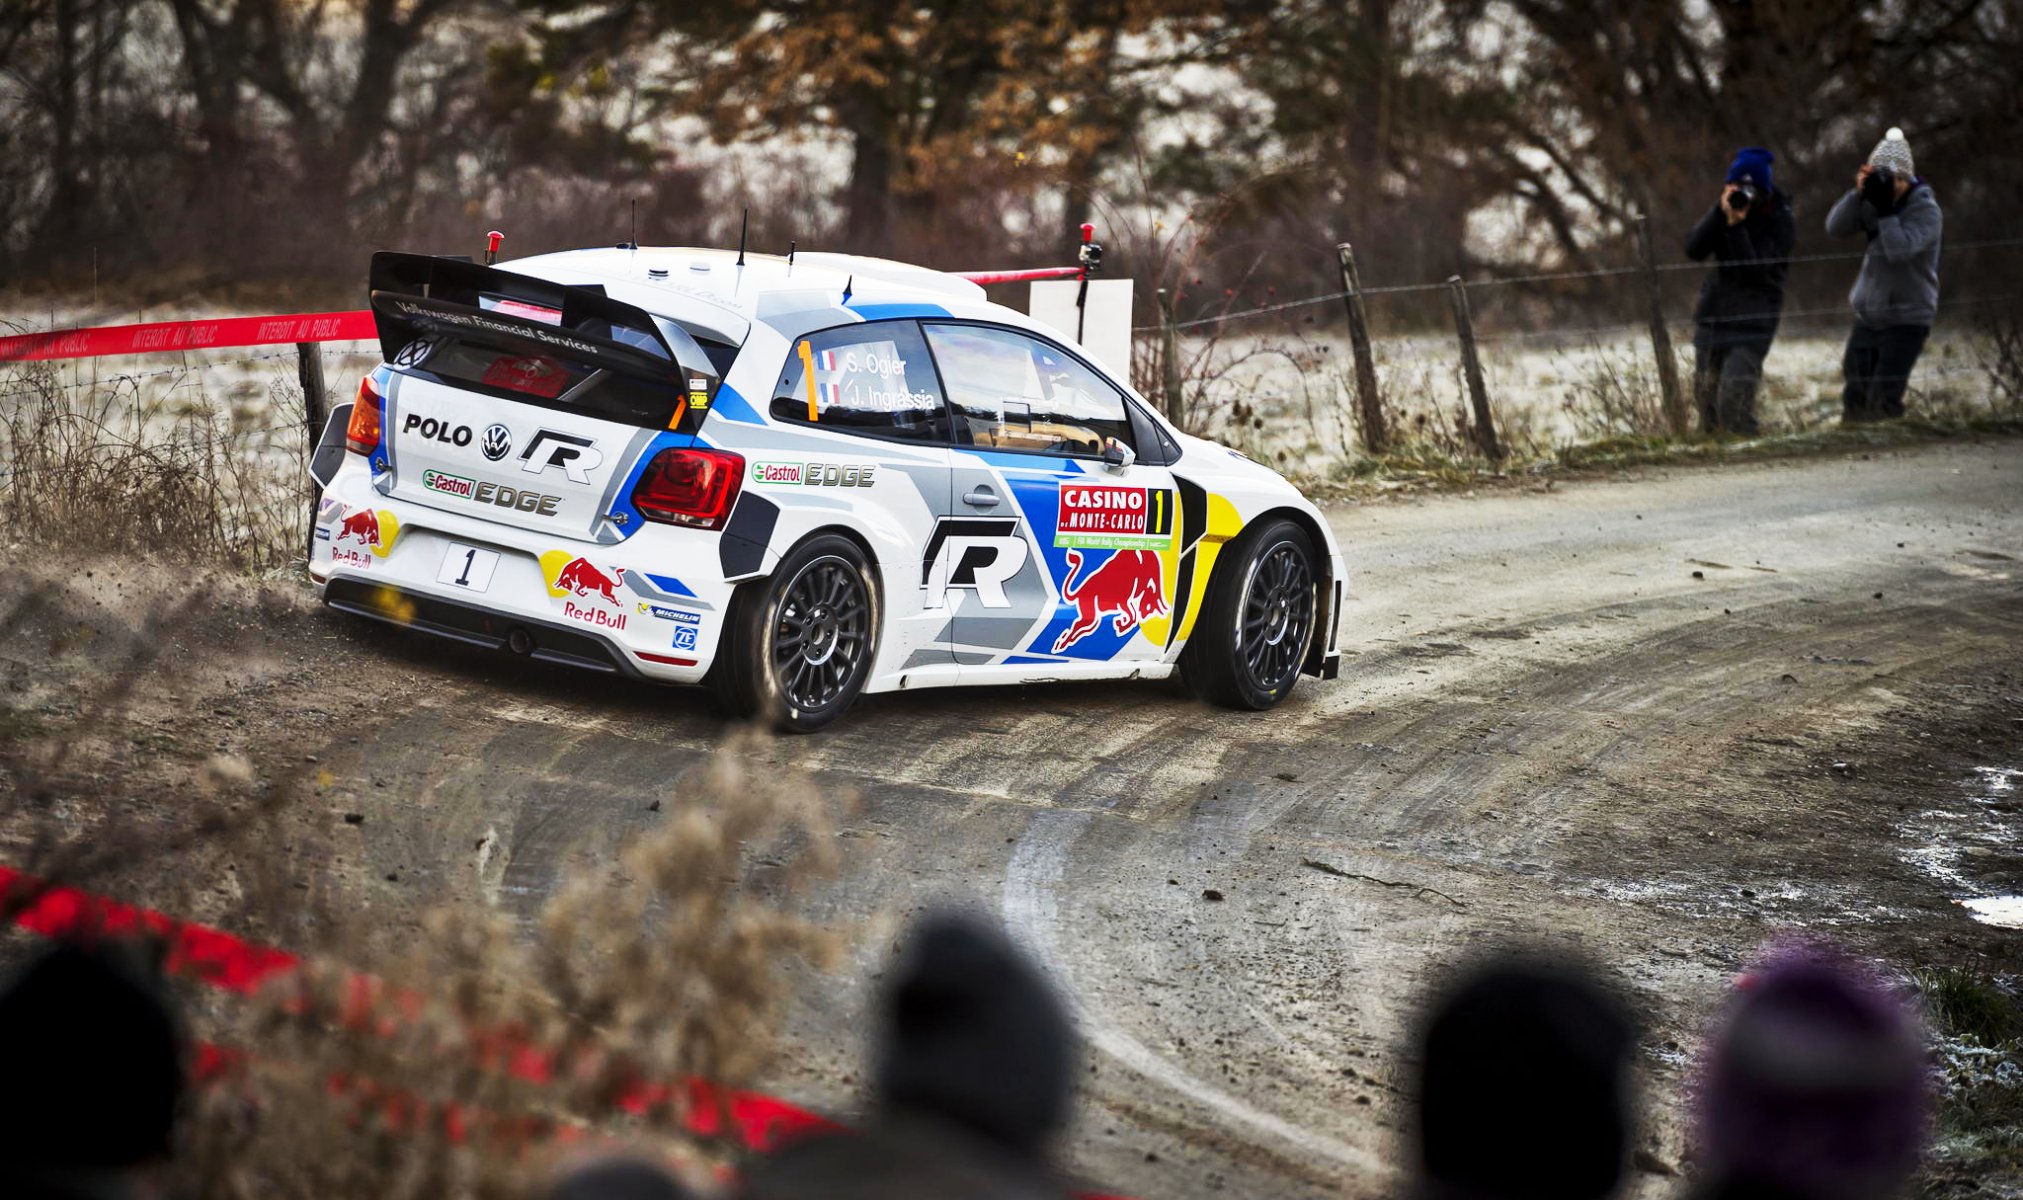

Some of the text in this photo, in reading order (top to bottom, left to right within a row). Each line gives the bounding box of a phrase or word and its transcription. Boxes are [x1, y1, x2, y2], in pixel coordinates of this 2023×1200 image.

[257, 318, 341, 341] INTERDIT AU PUBLIC
[395, 301, 598, 353] Volkswagen Financial Services
[846, 352, 906, 378] S. Ogier
[798, 341, 818, 421] 1
[851, 385, 935, 411] J. Ingrassia
[403, 413, 472, 447] POLO
[517, 426, 603, 485] R
[764, 463, 876, 488] Castrol EDGE
[434, 474, 562, 517] Castrol EDGE
[1064, 489, 1143, 510] CASINO
[1070, 512, 1144, 530] MONTE-CARLO
[1155, 490, 1163, 534] 1
[332, 546, 372, 570] Red Bull
[455, 549, 476, 586] 1
[919, 514, 1030, 610] R
[564, 601, 627, 630] Red Bull
[655, 608, 700, 623] MICHELIN
